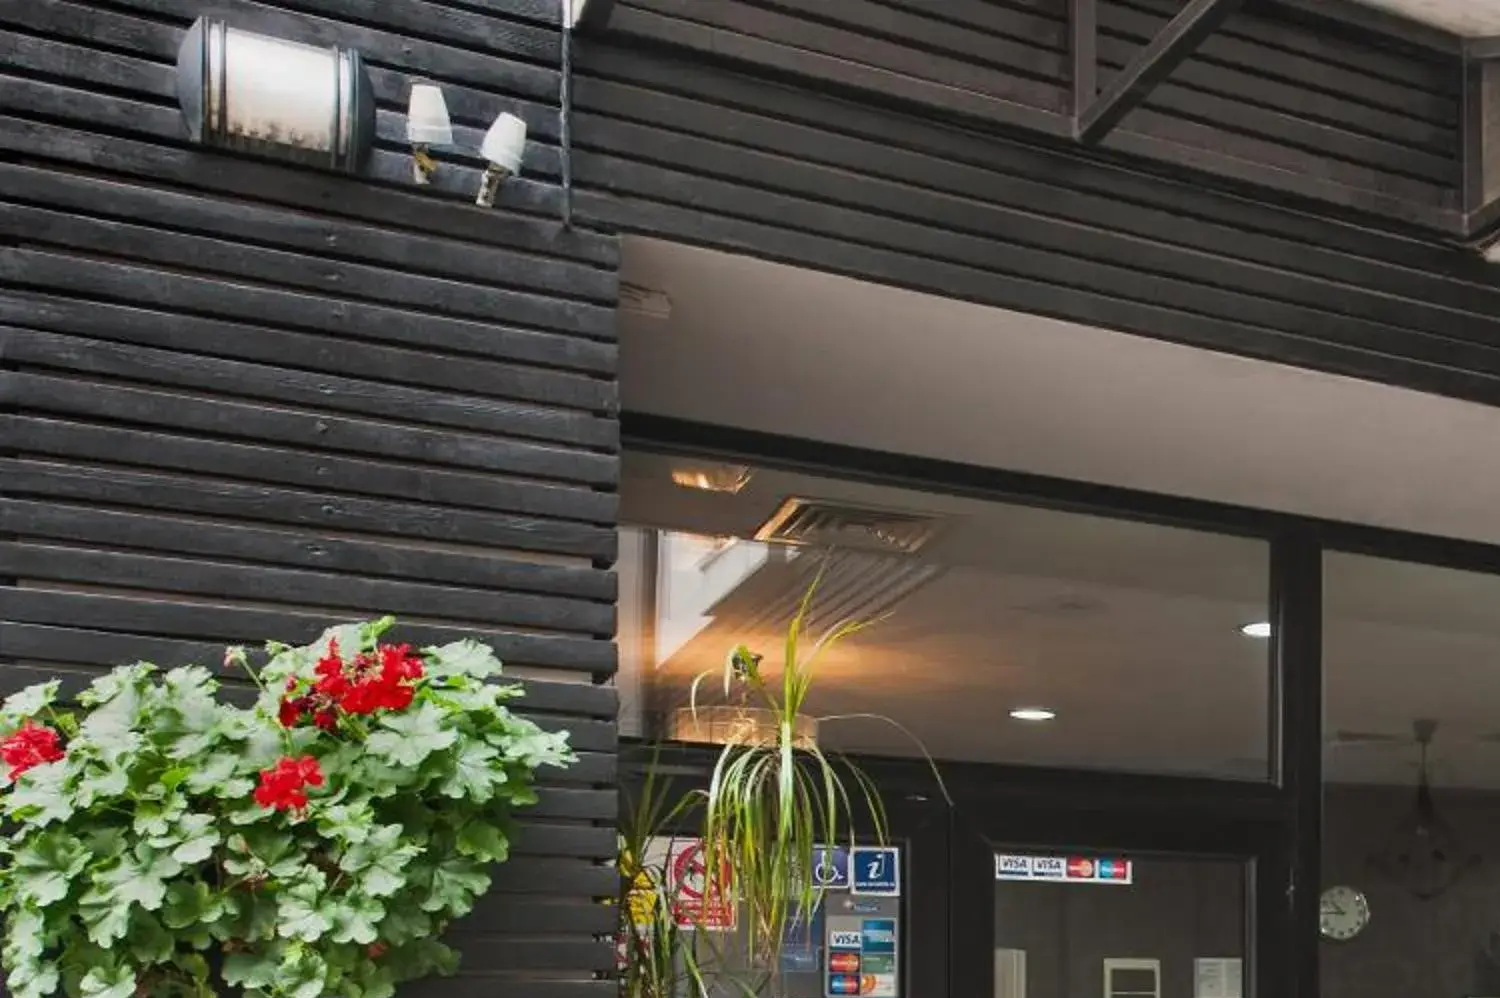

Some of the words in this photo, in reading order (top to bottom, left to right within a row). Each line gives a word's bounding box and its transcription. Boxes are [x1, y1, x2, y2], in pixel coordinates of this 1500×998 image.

[1003, 856, 1027, 868] VISA
[1038, 858, 1061, 869] VISA
[834, 934, 859, 945] VISA
